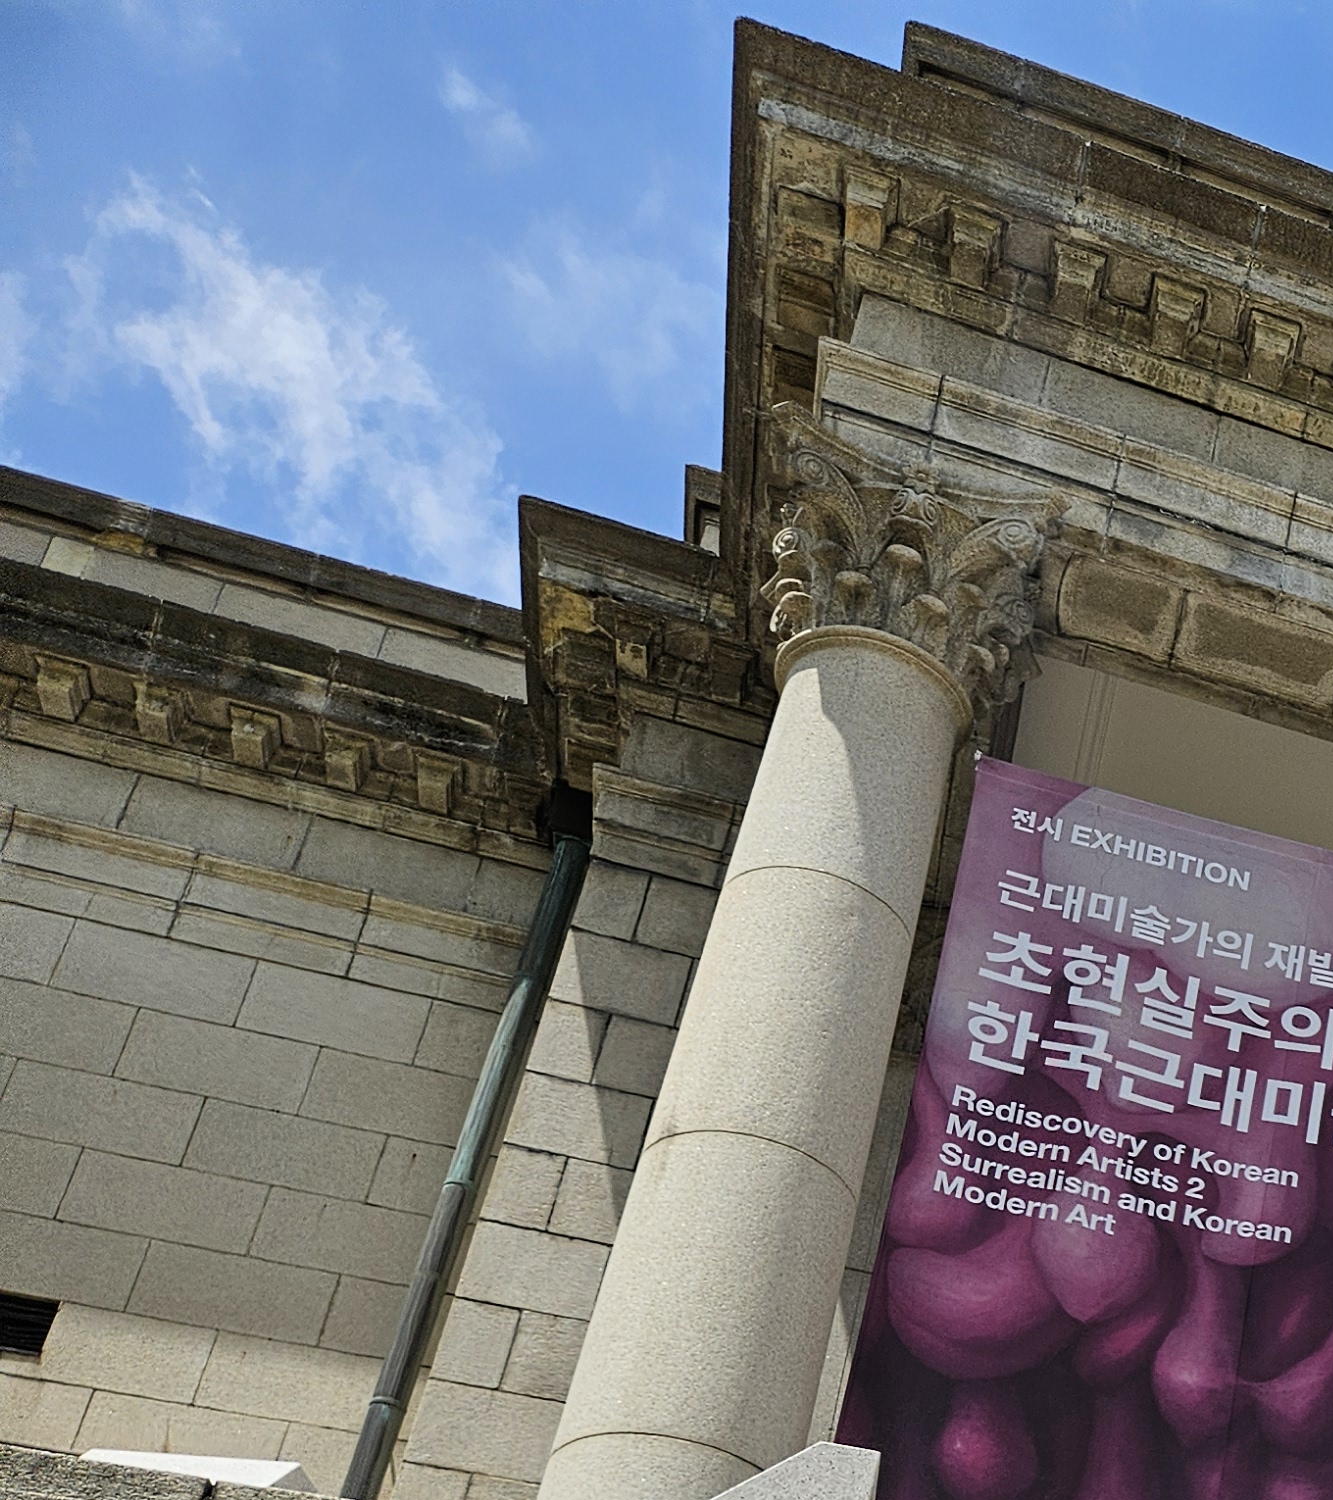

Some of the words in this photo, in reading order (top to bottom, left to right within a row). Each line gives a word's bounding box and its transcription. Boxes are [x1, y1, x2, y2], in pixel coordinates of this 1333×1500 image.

[1012, 807, 1063, 842] 전시
[1071, 825, 1251, 891] EXHIBITION
[998, 870, 1254, 970] 근대미술가의
[946, 1115, 1071, 1167] Modern
[1076, 1146, 1180, 1193] Artists
[1185, 1176, 1205, 1199] 2
[952, 1085, 1147, 1157] Rediscovery
[1153, 1141, 1186, 1165] of
[1191, 1148, 1298, 1188] Korean
[934, 1170, 1059, 1223] Modern
[1064, 1204, 1116, 1236] Art
[939, 1143, 1111, 1205] Surrealism
[1118, 1193, 1176, 1222] and
[1183, 1205, 1292, 1244] Korean
